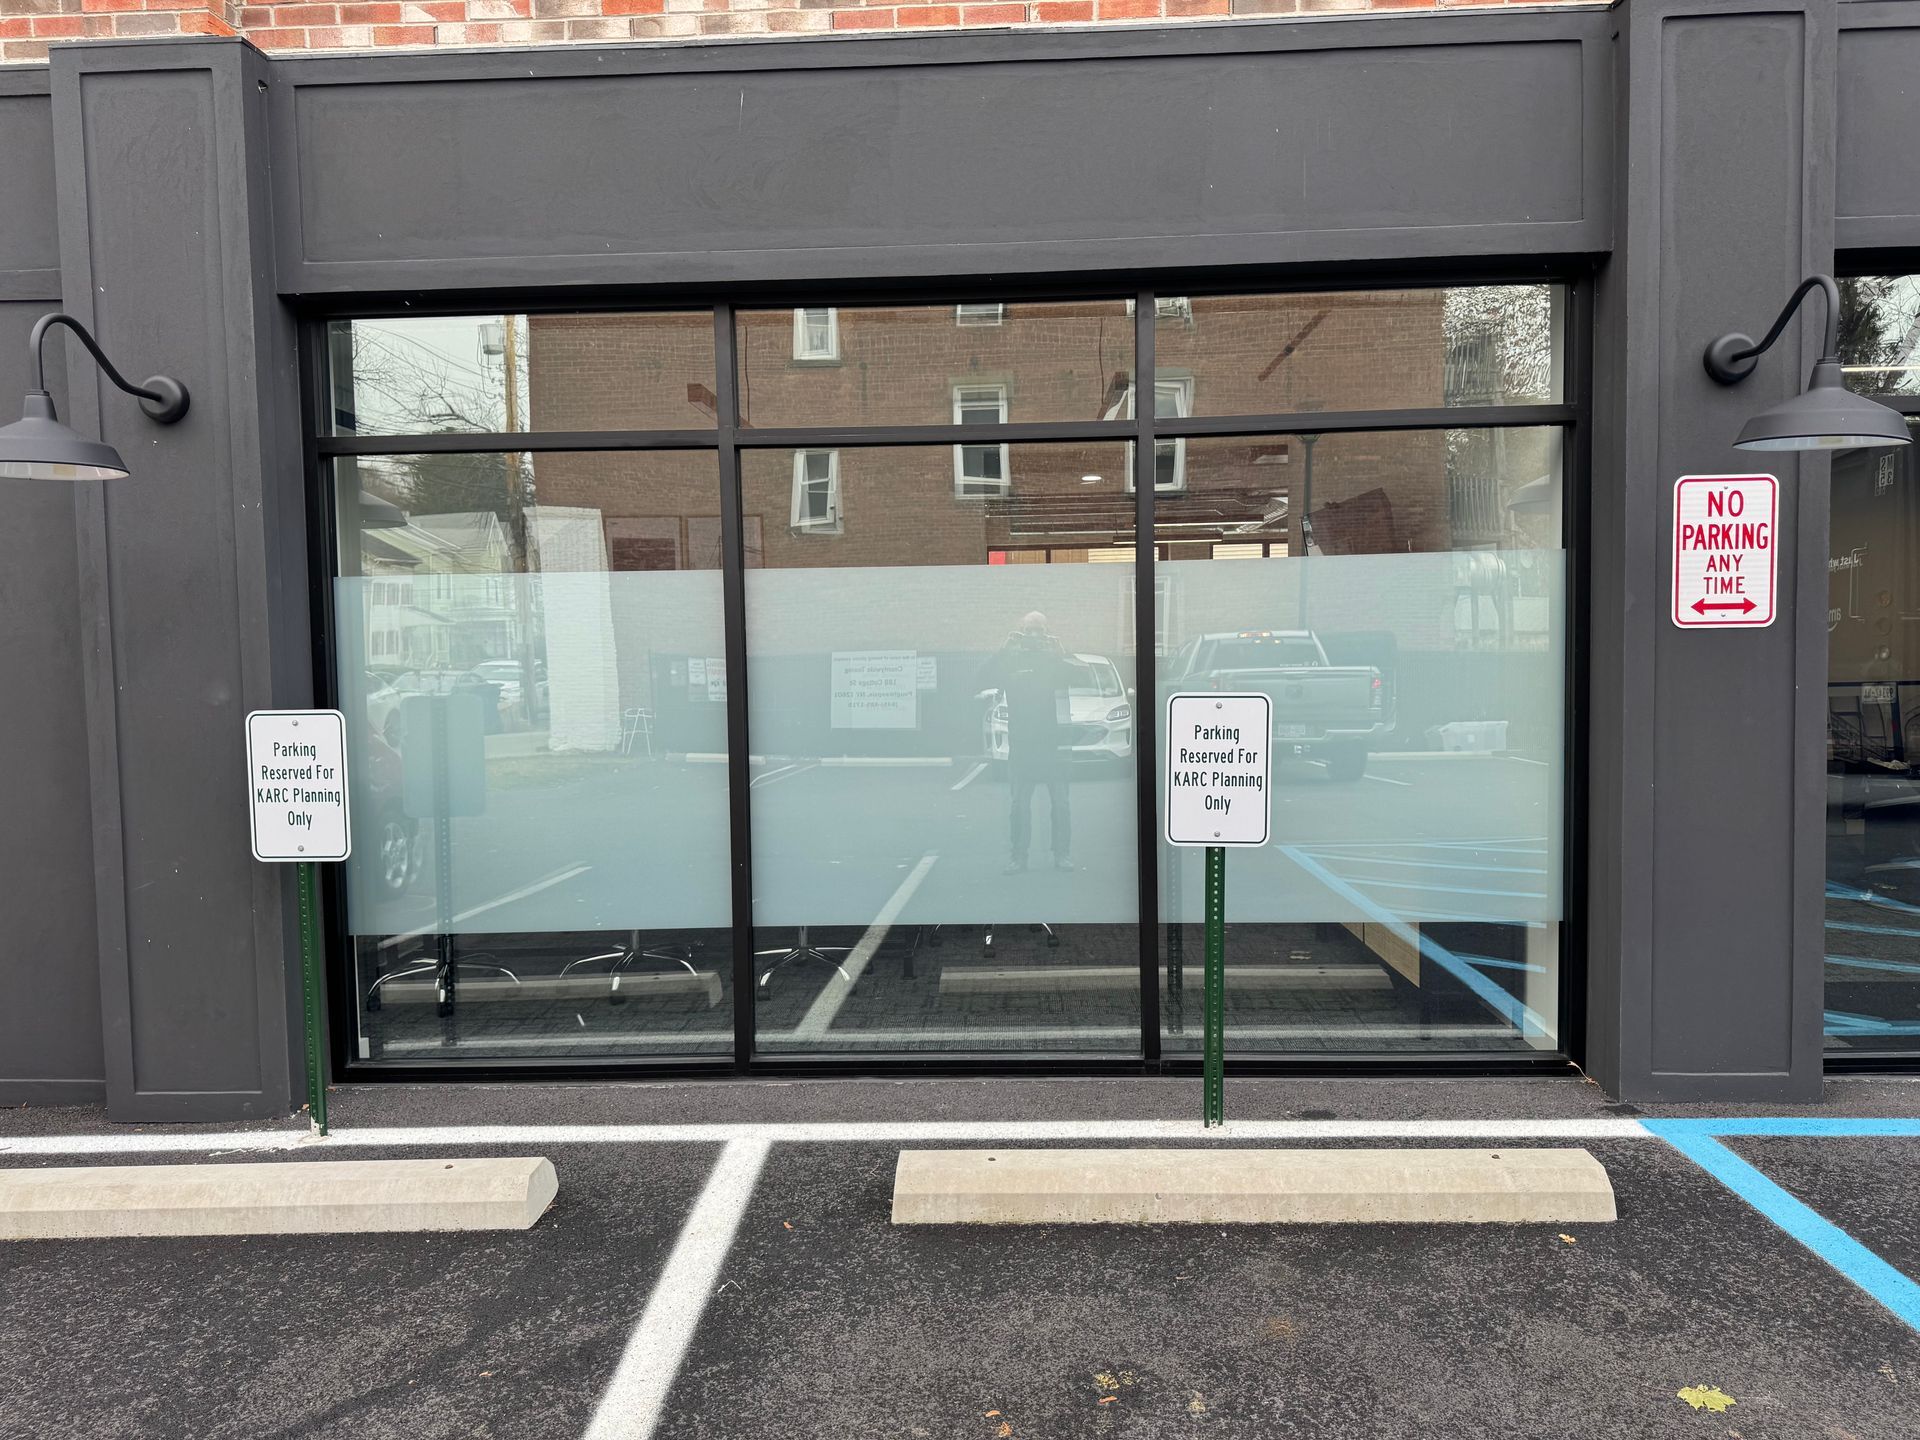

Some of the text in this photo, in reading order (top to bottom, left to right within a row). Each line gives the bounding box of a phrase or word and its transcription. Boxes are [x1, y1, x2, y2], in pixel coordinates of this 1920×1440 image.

[1707, 489, 1744, 518] NO
[1682, 522, 1769, 551] PARKING
[1705, 554, 1744, 572] ANY
[1703, 576, 1746, 594] TIME
[1194, 725, 1240, 744] Parking
[273, 742, 316, 761] Parking
[1180, 748, 1258, 763] Reserved For
[261, 765, 334, 780] Reserved For
[1174, 772, 1263, 792] KARC Planning
[257, 788, 341, 807] KARC Planning
[1205, 795, 1231, 815] Only
[287, 811, 312, 830] Only
